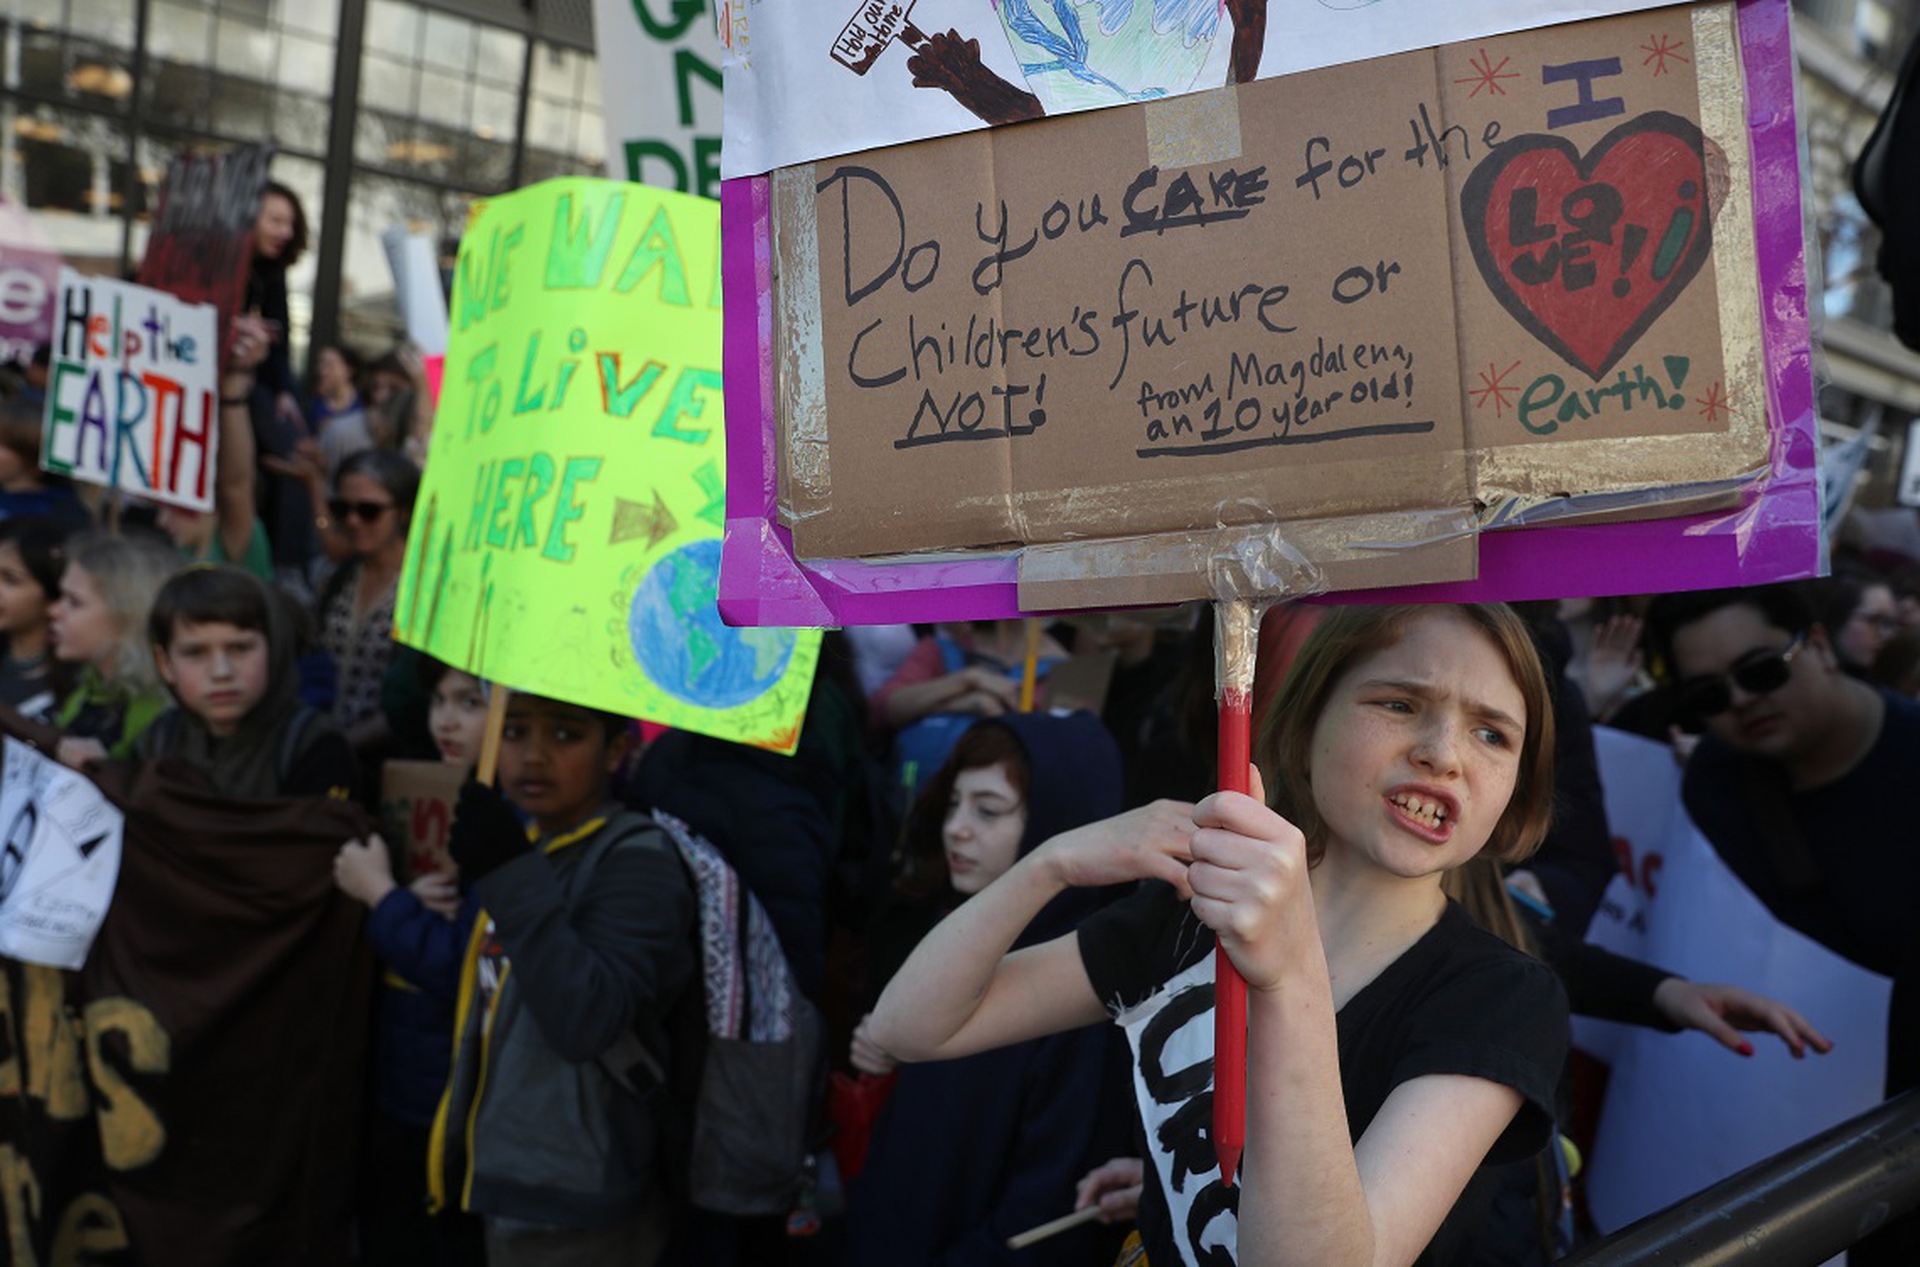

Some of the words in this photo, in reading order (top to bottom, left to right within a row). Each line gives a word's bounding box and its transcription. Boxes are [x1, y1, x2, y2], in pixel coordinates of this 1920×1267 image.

[837, 23, 867, 57] Hold
[867, 5, 903, 45] Home
[1542, 56, 1626, 130] I
[817, 166, 940, 306] Do
[972, 193, 1109, 296] you
[1295, 136, 1387, 200] for
[1404, 102, 1504, 171] the
[458, 222, 525, 332] WE
[544, 191, 722, 308] WA
[61, 287, 143, 378] Help
[143, 305, 198, 364] the
[848, 306, 1100, 388] Children's
[1109, 258, 1298, 391] future
[1332, 259, 1402, 304] or
[44, 360, 212, 500] EARTH
[1137, 373, 1214, 417] from
[1147, 412, 1194, 442] an
[1201, 397, 1262, 442] 10
[1272, 389, 1344, 439] year
[1517, 354, 1691, 436] earth!
[461, 451, 606, 564] HERE
